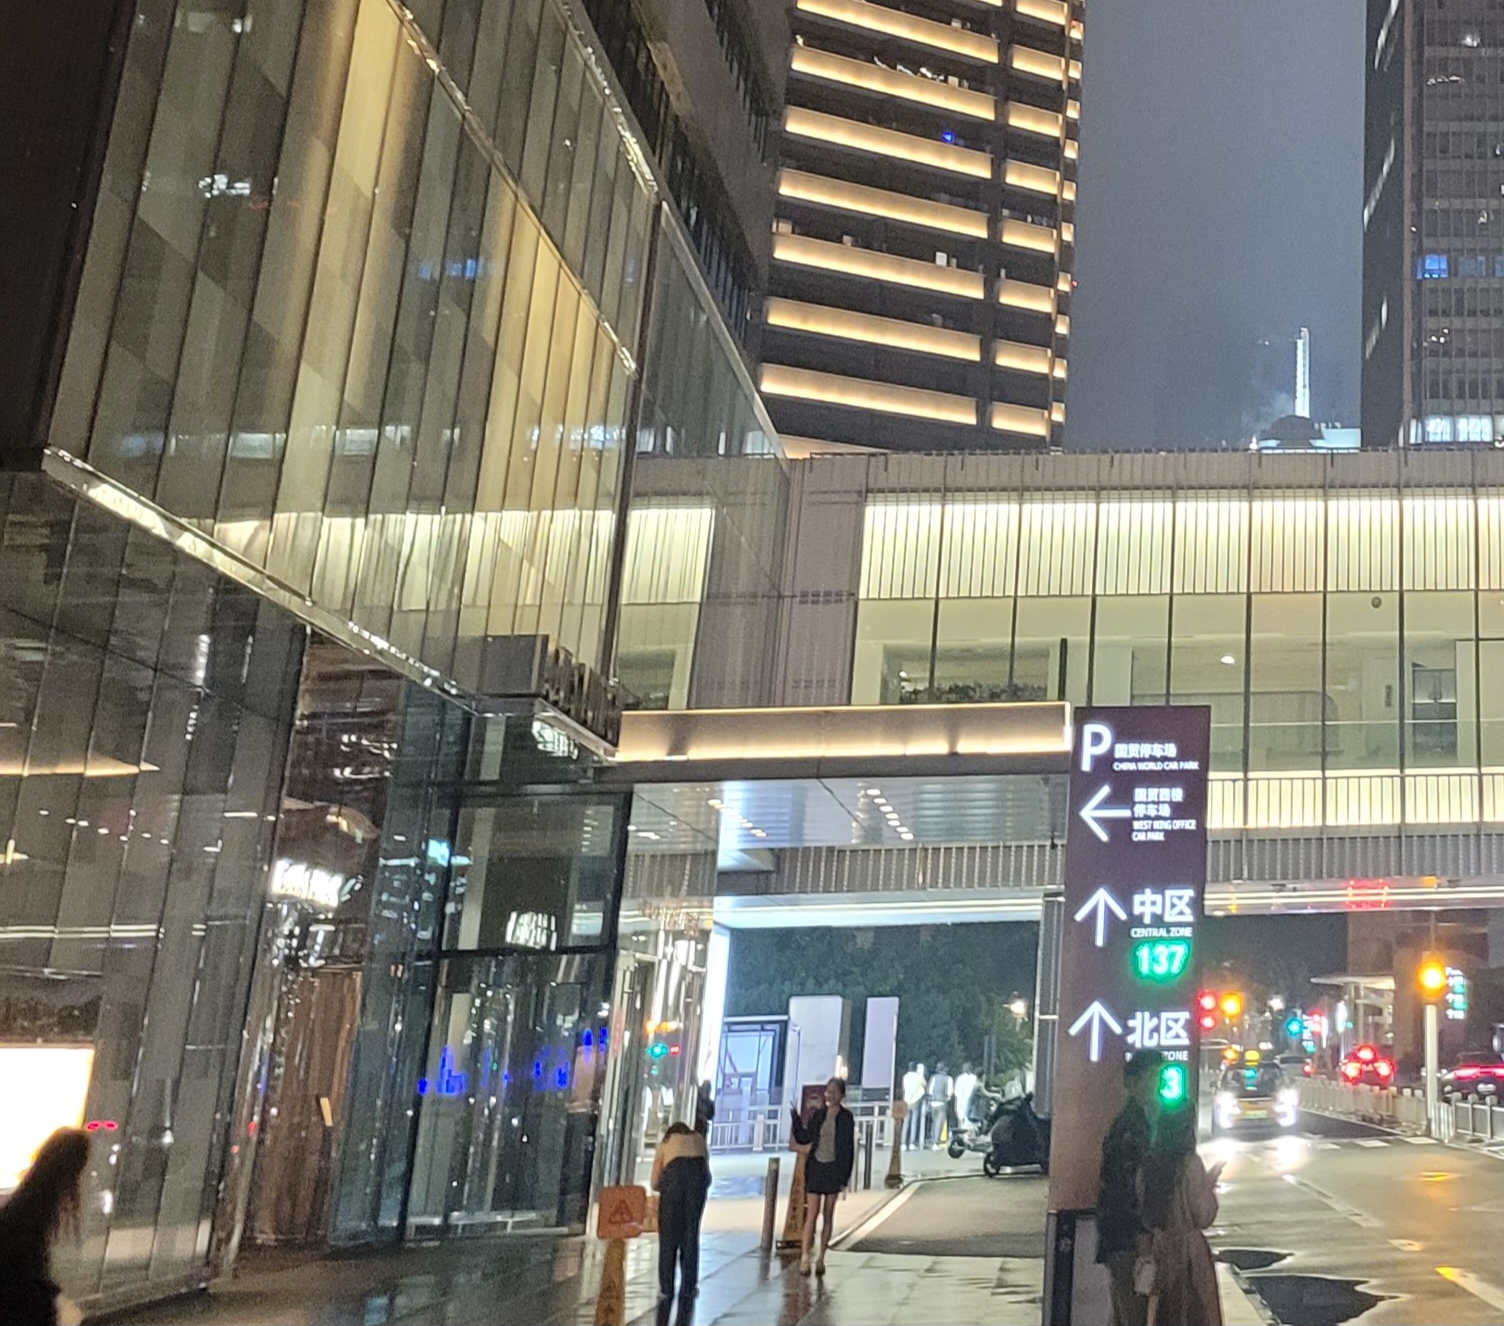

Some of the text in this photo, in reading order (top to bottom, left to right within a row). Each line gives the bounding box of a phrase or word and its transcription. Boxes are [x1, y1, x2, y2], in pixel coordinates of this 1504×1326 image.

[1081, 723, 1113, 773] P
[1113, 761, 1199, 771] CHINA WORLD CAR PARK
[1132, 820, 1152, 830] WEST
[1172, 819, 1197, 830] OFFICE
[1132, 831, 1165, 841] CAR PARK
[1132, 887, 1195, 925] 中区
[1130, 926, 1193, 938] CENTRAL ZONE
[1136, 944, 1186, 975] 137
[1125, 1011, 1191, 1049] 北区
